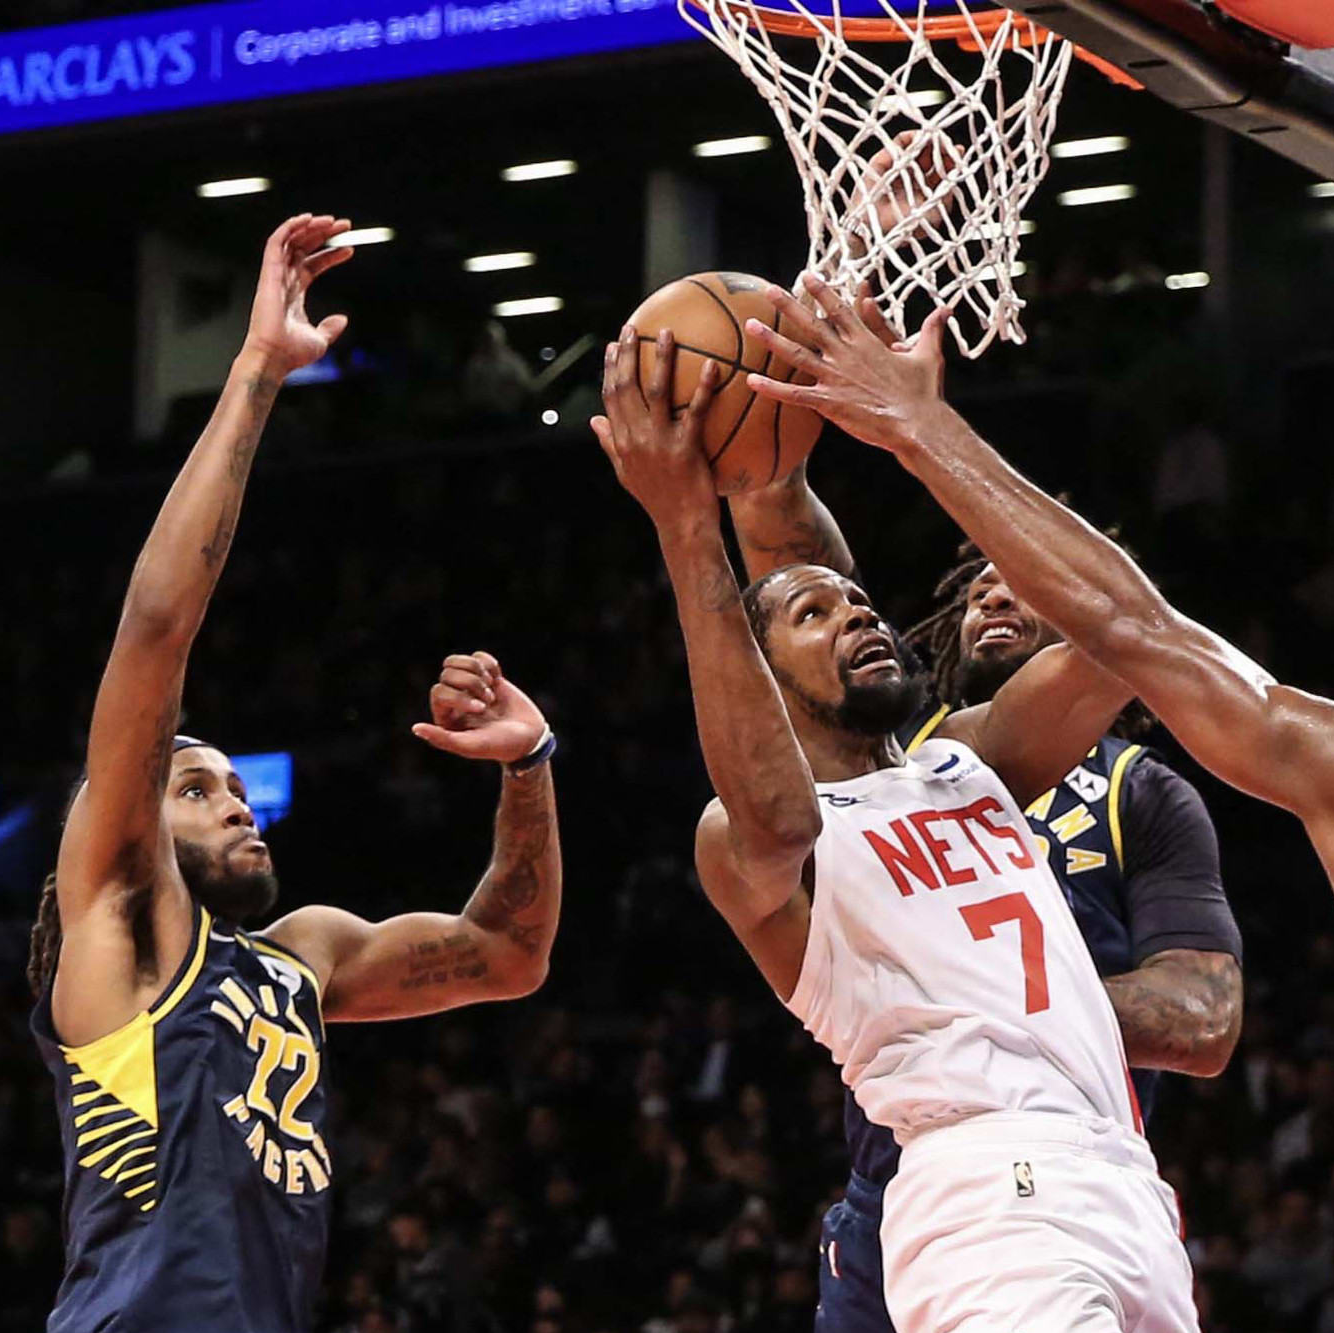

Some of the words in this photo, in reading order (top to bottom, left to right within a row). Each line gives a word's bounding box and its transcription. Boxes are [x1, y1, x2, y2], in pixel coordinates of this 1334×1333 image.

[235, 19, 382, 66] Corporate
[384, 4, 441, 45] and
[862, 796, 1036, 898] NETS
[958, 891, 1050, 1015] 7
[247, 1013, 321, 1141] 22
